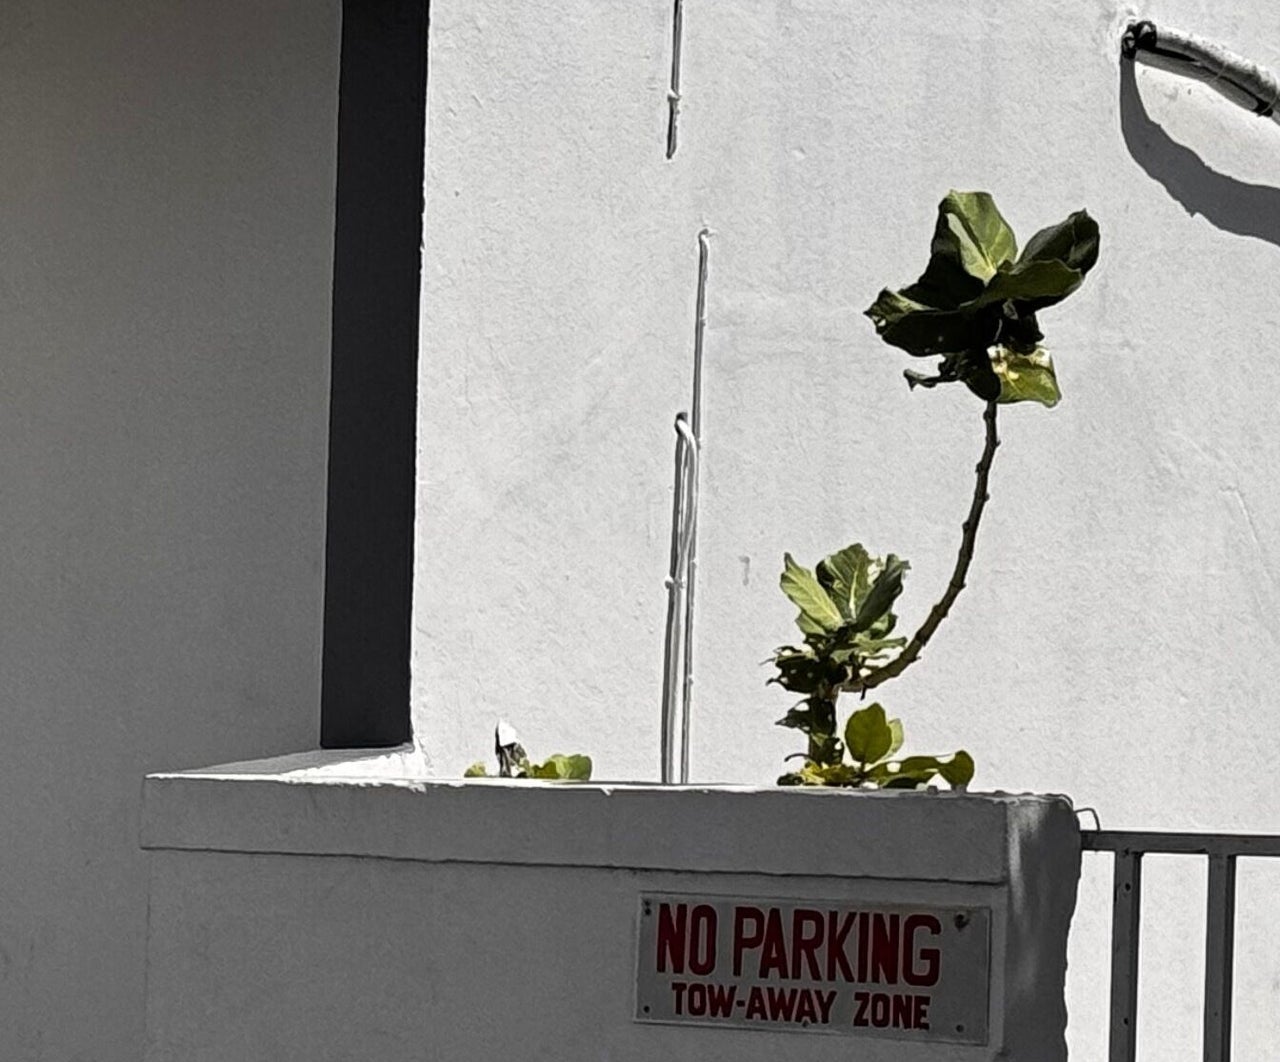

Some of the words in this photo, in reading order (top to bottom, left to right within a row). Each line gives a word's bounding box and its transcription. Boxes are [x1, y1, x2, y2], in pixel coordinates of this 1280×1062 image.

[656, 903, 717, 976] NO
[733, 906, 942, 987] PARKING
[672, 983, 837, 1025] TOW-AWAY
[853, 992, 931, 1030] ZONE
